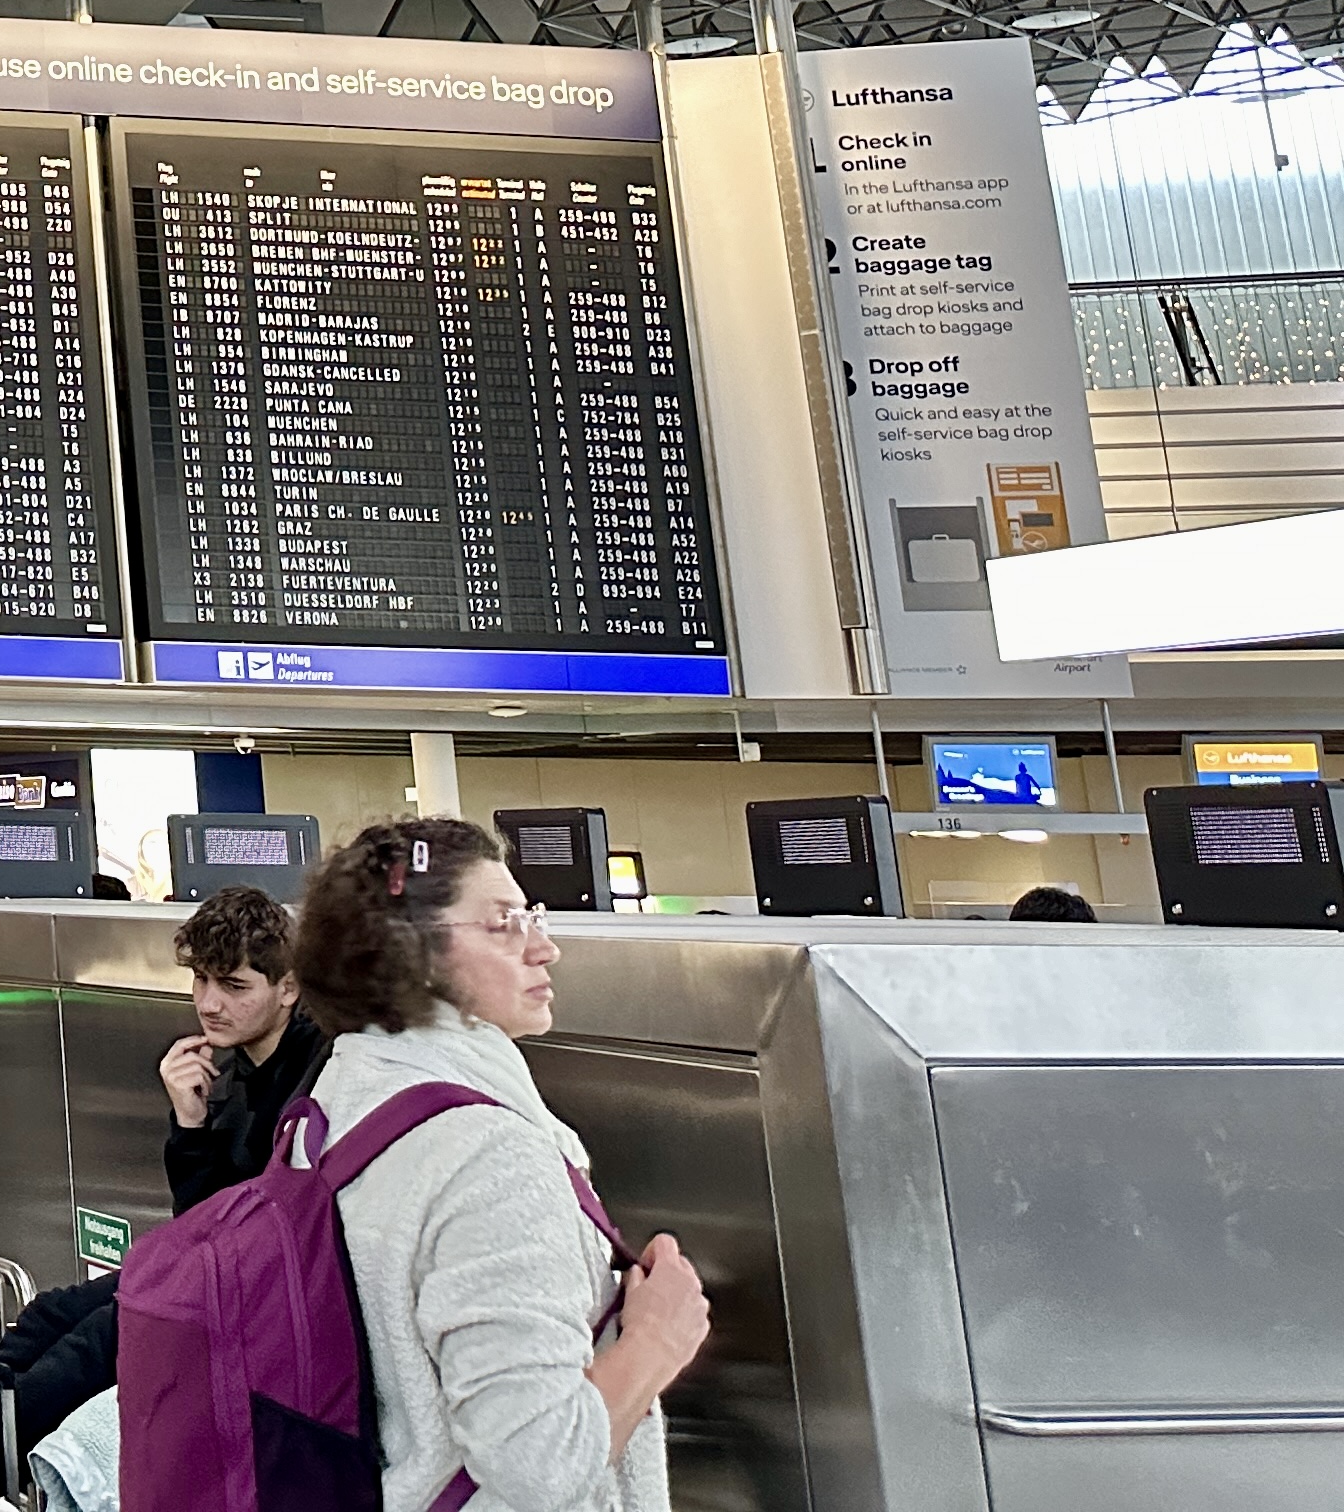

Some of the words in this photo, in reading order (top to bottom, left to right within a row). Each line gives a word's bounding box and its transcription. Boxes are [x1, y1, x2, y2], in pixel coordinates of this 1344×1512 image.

[48, 56, 132, 83] online
[139, 59, 260, 90] check-in
[267, 67, 320, 92] and
[326, 68, 486, 100] self-service
[491, 76, 544, 108] bag
[550, 79, 614, 112] drop
[832, 87, 953, 106] Lufthansa
[838, 133, 909, 151] Check
[912, 132, 932, 146] in
[841, 156, 906, 172] online
[845, 184, 859, 196] In
[863, 181, 889, 194] the
[893, 179, 973, 193] Lufthansa
[978, 178, 1009, 191] app
[847, 205, 863, 215] or
[867, 202, 882, 213] at
[886, 197, 1001, 213] lufthansa.com
[852, 236, 926, 251] Create
[855, 256, 951, 275] baggage
[955, 254, 992, 271] tag
[859, 284, 896, 297] Print
[901, 284, 916, 295] at
[920, 280, 1015, 295] self-service
[861, 304, 891, 319] bag
[896, 302, 933, 317] drop
[938, 300, 989, 314] kiosks
[993, 299, 1024, 311] and
[864, 323, 915, 336] attach
[920, 323, 936, 334] to
[940, 320, 1013, 336] baggage
[869, 359, 923, 376] Drop
[929, 356, 960, 372] off
[872, 380, 969, 399] baggage
[875, 407, 924, 422] Quick
[928, 407, 958, 419] and
[963, 406, 1001, 421] easy
[1004, 406, 1021, 417] at
[1025, 404, 1052, 416] the
[878, 427, 973, 442] self-service
[977, 426, 1008, 441] bag
[1013, 425, 1052, 440] drop
[881, 447, 932, 461] kiosks
[275, 487, 318, 500] TURIN
[279, 540, 348, 554] BUDAPEST
[280, 558, 351, 573] WARSCHAU
[282, 575, 397, 591] FUERTEVENTURA
[286, 612, 339, 626] VERONA
[682, 622, 707, 634] B11
[277, 653, 311, 667] Abflug
[278, 668, 334, 682] Departures
[1054, 663, 1091, 674] Airport
[1227, 751, 1293, 764] Lufthansa
[938, 818, 962, 830] 136
